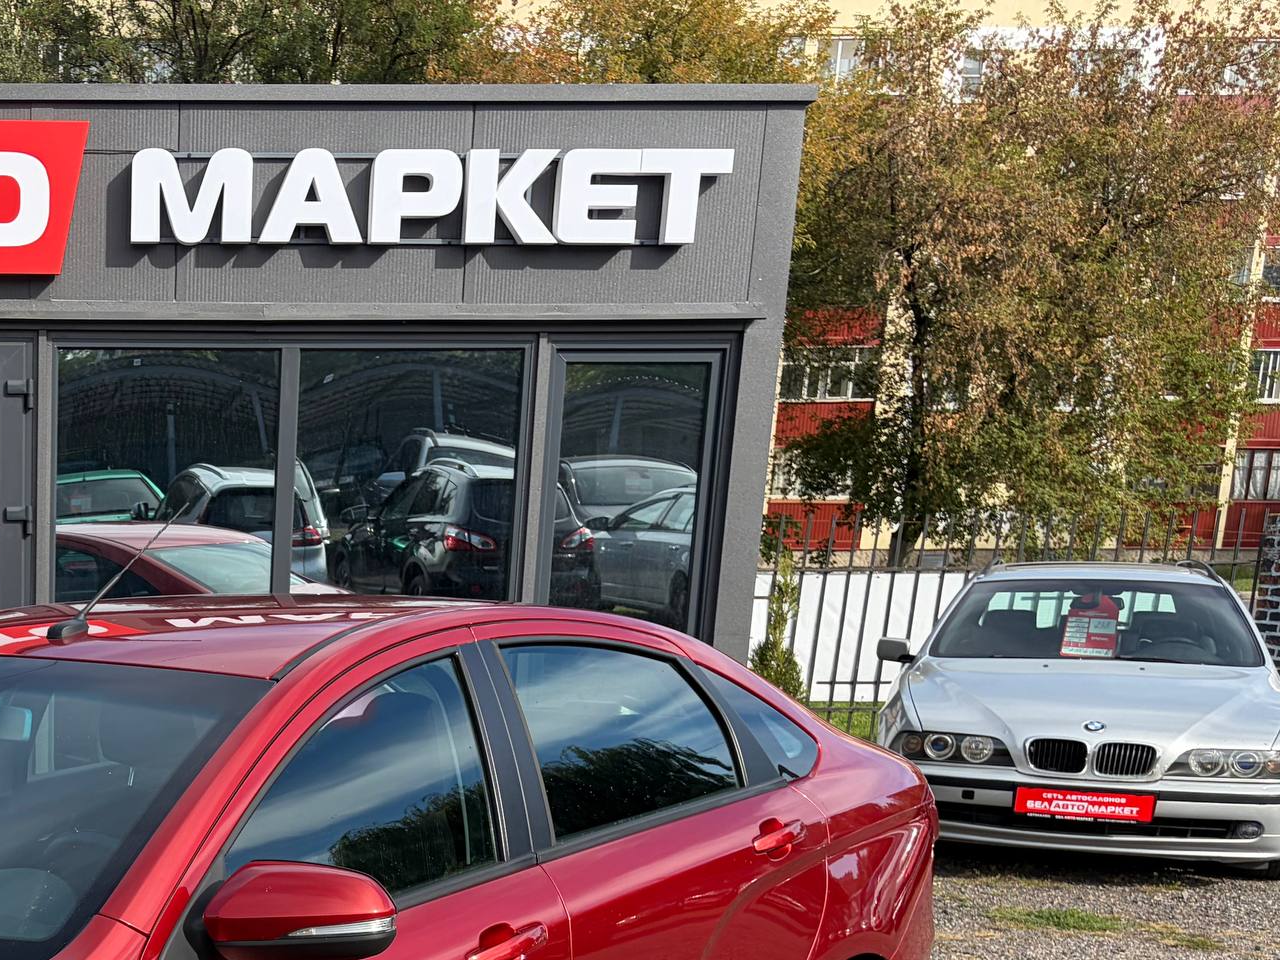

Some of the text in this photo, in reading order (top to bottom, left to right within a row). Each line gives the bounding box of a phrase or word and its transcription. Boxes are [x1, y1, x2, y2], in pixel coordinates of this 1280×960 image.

[130, 147, 735, 247] МАРКЕТ
[1065, 794, 1127, 804] АВТОСАЛОНОВ
[1026, 800, 1140, 816] БЕЛ АВТО МАРКЕТ
